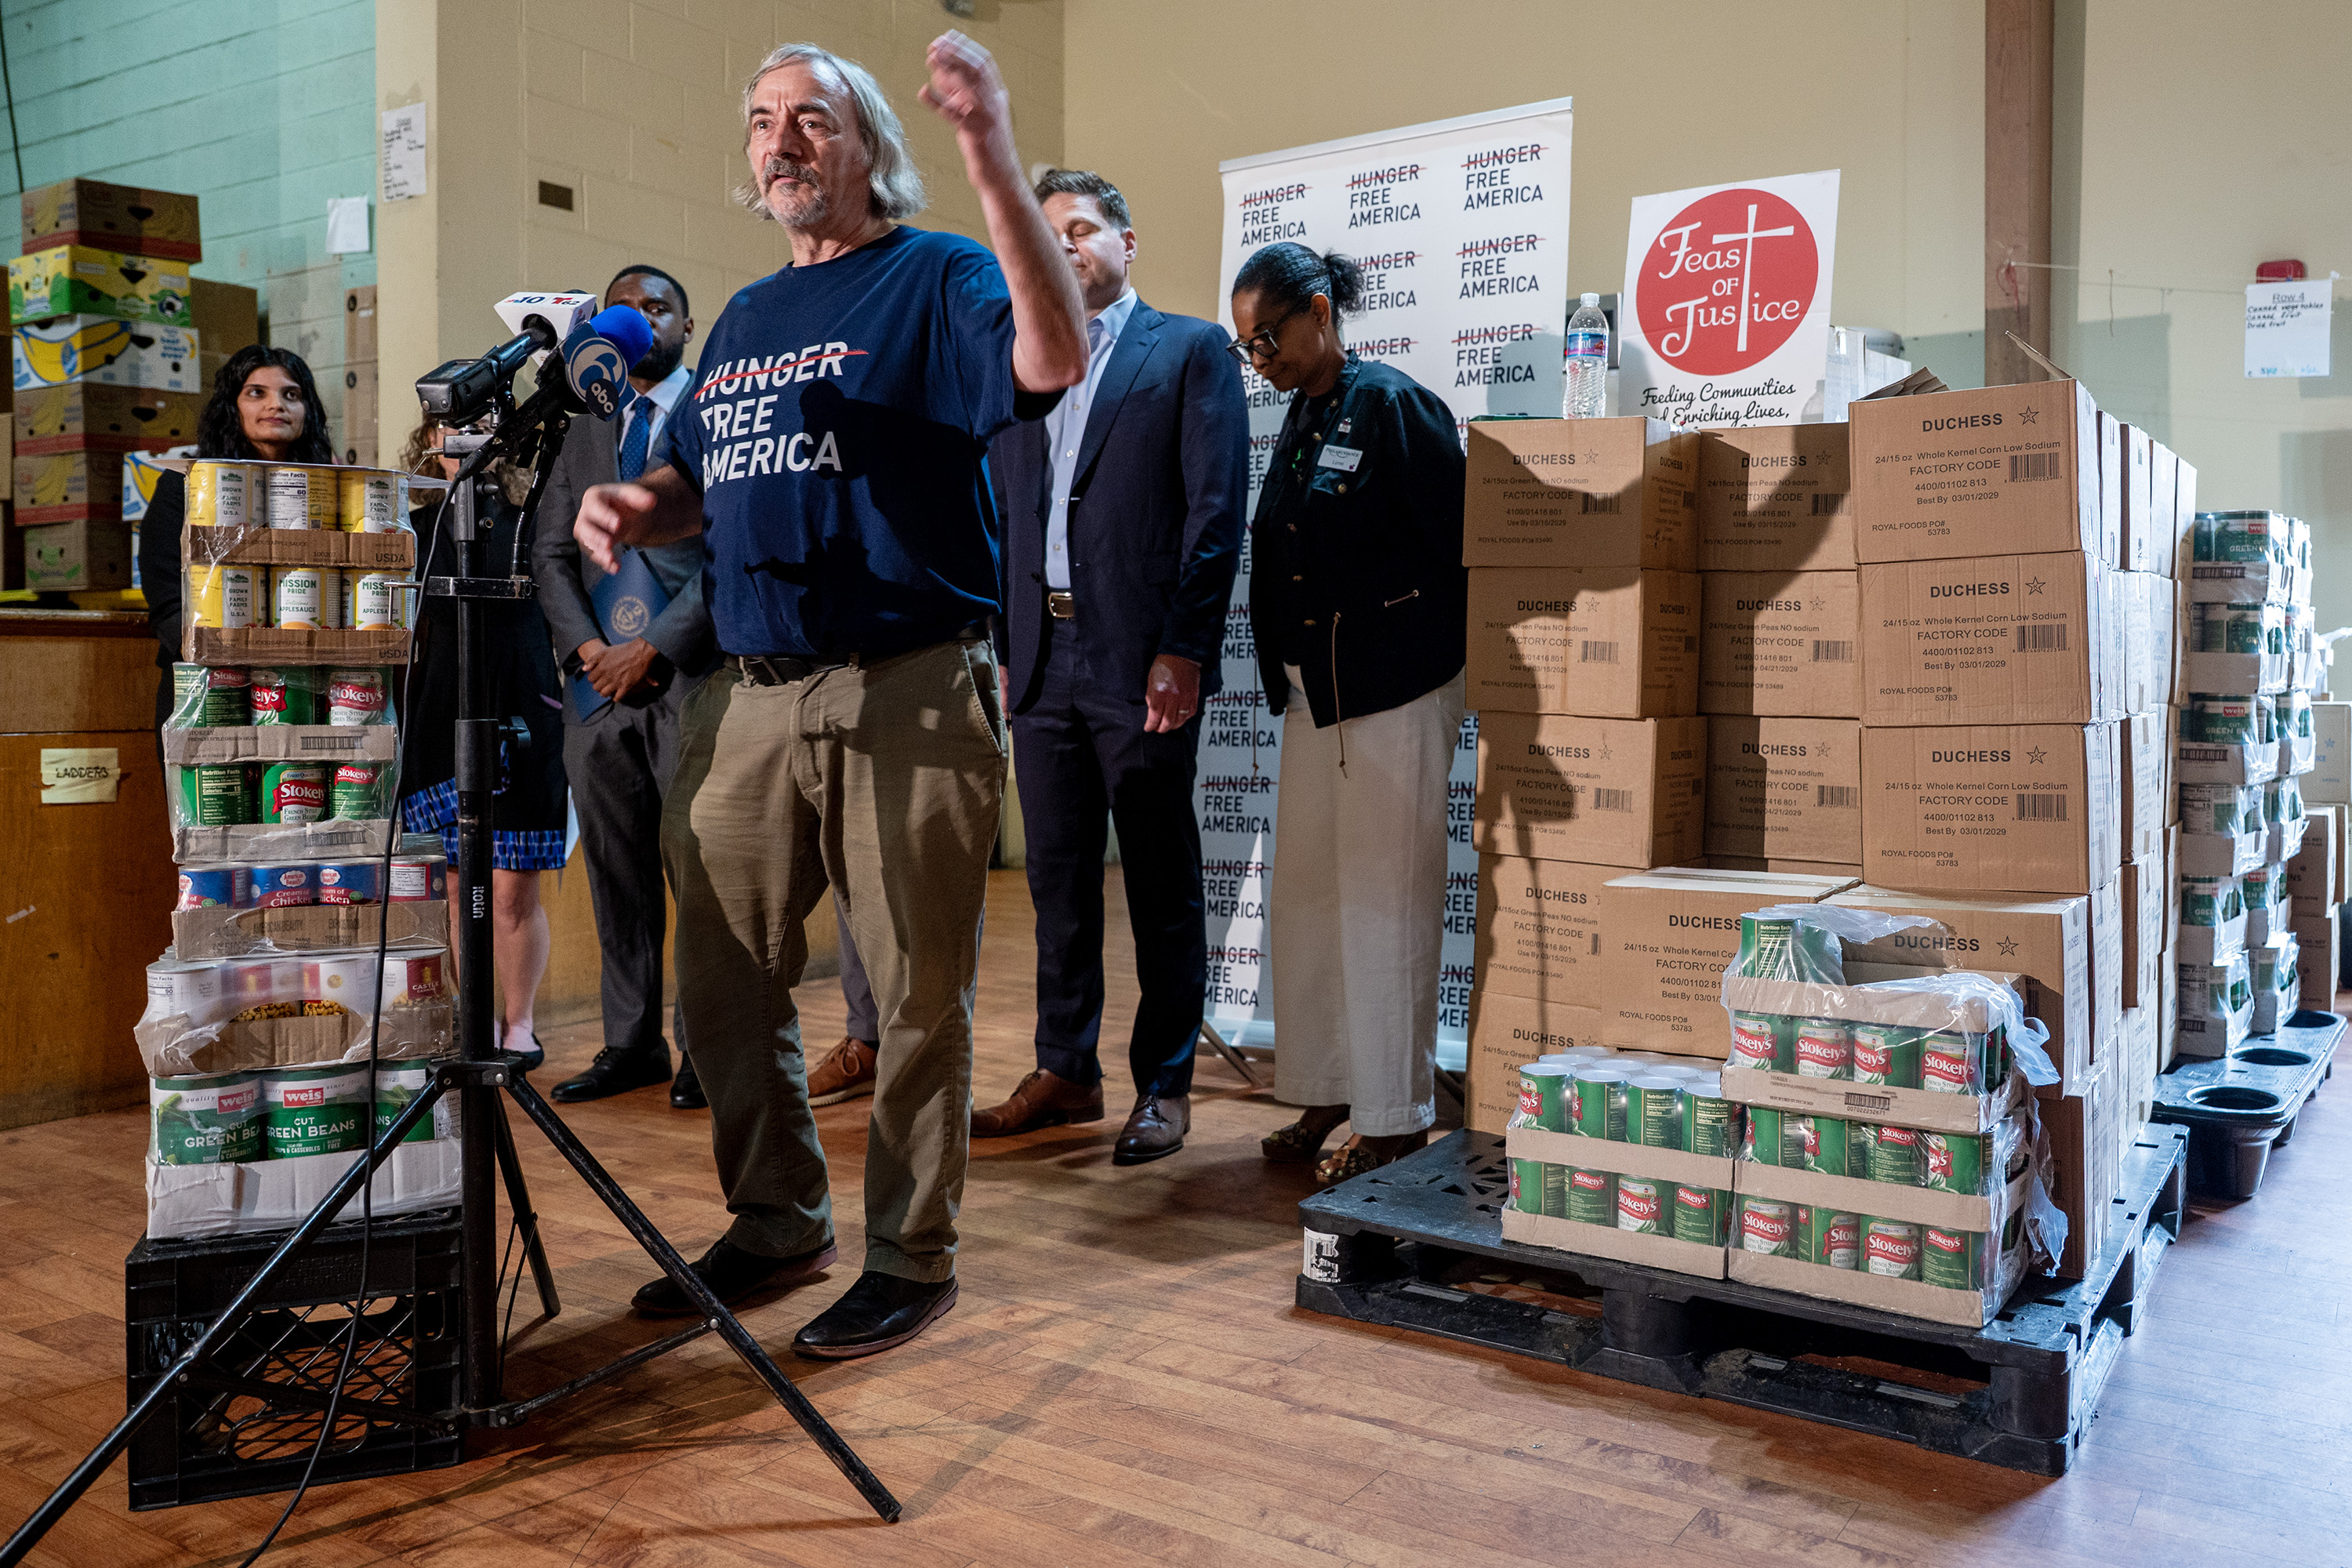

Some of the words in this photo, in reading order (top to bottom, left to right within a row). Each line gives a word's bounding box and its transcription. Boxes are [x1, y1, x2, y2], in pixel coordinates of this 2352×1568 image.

[1468, 144, 1541, 170] HUNGER
[1351, 165, 1419, 190] HUNGER
[1466, 169, 1510, 190] FREE
[1243, 183, 1305, 209] HUNGER
[1350, 189, 1391, 209] FREE
[1464, 185, 1543, 211] AMERICA
[1243, 208, 1279, 227] FREE
[1348, 204, 1421, 228] AMERICA
[1242, 222, 1306, 247] AMERICA
[1462, 235, 1537, 258] HUNGER
[1461, 259, 1505, 278] FREE
[1459, 276, 1539, 299] AMERICA
[1712, 278, 1739, 296] OF
[2273, 293, 2296, 303] Row
[2298, 292, 2305, 301] 4
[1661, 292, 1800, 358] Justice
[1457, 324, 1533, 347] HUNGER
[1457, 347, 1501, 367] FREE
[699, 342, 848, 403] HUNGER
[1455, 365, 1535, 387] AMERICA
[591, 383, 614, 413] abc
[1641, 385, 1696, 409] Feeding
[1700, 378, 1796, 402] Communities
[700, 394, 778, 441] FREE
[1673, 404, 1741, 428] Enriching
[1922, 413, 2003, 432] DUCHESS
[1513, 454, 1575, 465] DUCHESS
[1875, 455, 1900, 463] 24/15
[1947, 448, 1977, 457] Kernel
[2026, 441, 2060, 450] Sodium
[702, 431, 843, 492] AMERICA
[1741, 455, 1807, 468] DUCHESS
[1910, 463, 1964, 476] FACTORY
[1967, 459, 2001, 470] CODE
[1915, 480, 1967, 492] 4400/01102
[1969, 478, 1987, 487] 813
[1917, 496, 1935, 505] Best
[1937, 495, 1947, 505] By
[1952, 492, 1998, 502] 03/01/2029
[376, 554, 405, 563] USDA
[279, 579, 317, 588] MISSION
[1930, 583, 2009, 597] DUCHESS
[1518, 601, 1577, 612] DUCHESS
[1737, 600, 1801, 612] DUCHESS
[1918, 630, 1971, 640] FACTORY
[1974, 628, 2007, 637] CODE
[379, 649, 408, 659] USDA
[1210, 710, 1248, 727] FREE
[1208, 730, 1276, 746] AMERICA
[1529, 746, 1590, 758] DUCHESS
[1742, 742, 1807, 757] DUCHESS
[1932, 750, 2011, 763] DUCHESS
[56, 766, 109, 779] LADDERS
[1206, 776, 1270, 793] HUNGER
[1204, 796, 1243, 812] FREE
[1919, 796, 1973, 805] FACTORY
[1976, 796, 2008, 805] CODE
[1202, 815, 1270, 833] AMERICA
[285, 878, 303, 887] Beauty
[270, 897, 313, 907] Chicken
[1526, 887, 1587, 904] DUCHESS
[1669, 915, 1740, 931] DUCHESS
[1894, 935, 1980, 952] DUCHESS
[412, 981, 439, 991] CASTLE
[1513, 1029, 1573, 1047] DUCHESS
[1798, 1040, 1847, 1061] Stokely's
[1925, 1054, 1976, 1075] Stokely's
[221, 1091, 254, 1107] weis
[285, 1090, 321, 1102] weis
[266, 1126, 302, 1138] GREEN
[308, 1120, 355, 1137] BEANS
[294, 1117, 315, 1126] CUT
[1574, 1172, 1604, 1186] Stokely's
[1679, 1188, 1707, 1203] Stokely's
[1744, 1213, 1789, 1234] Stokely's
[1869, 1236, 1919, 1258] Stokely's
[1929, 1230, 1961, 1247] Stokely's
